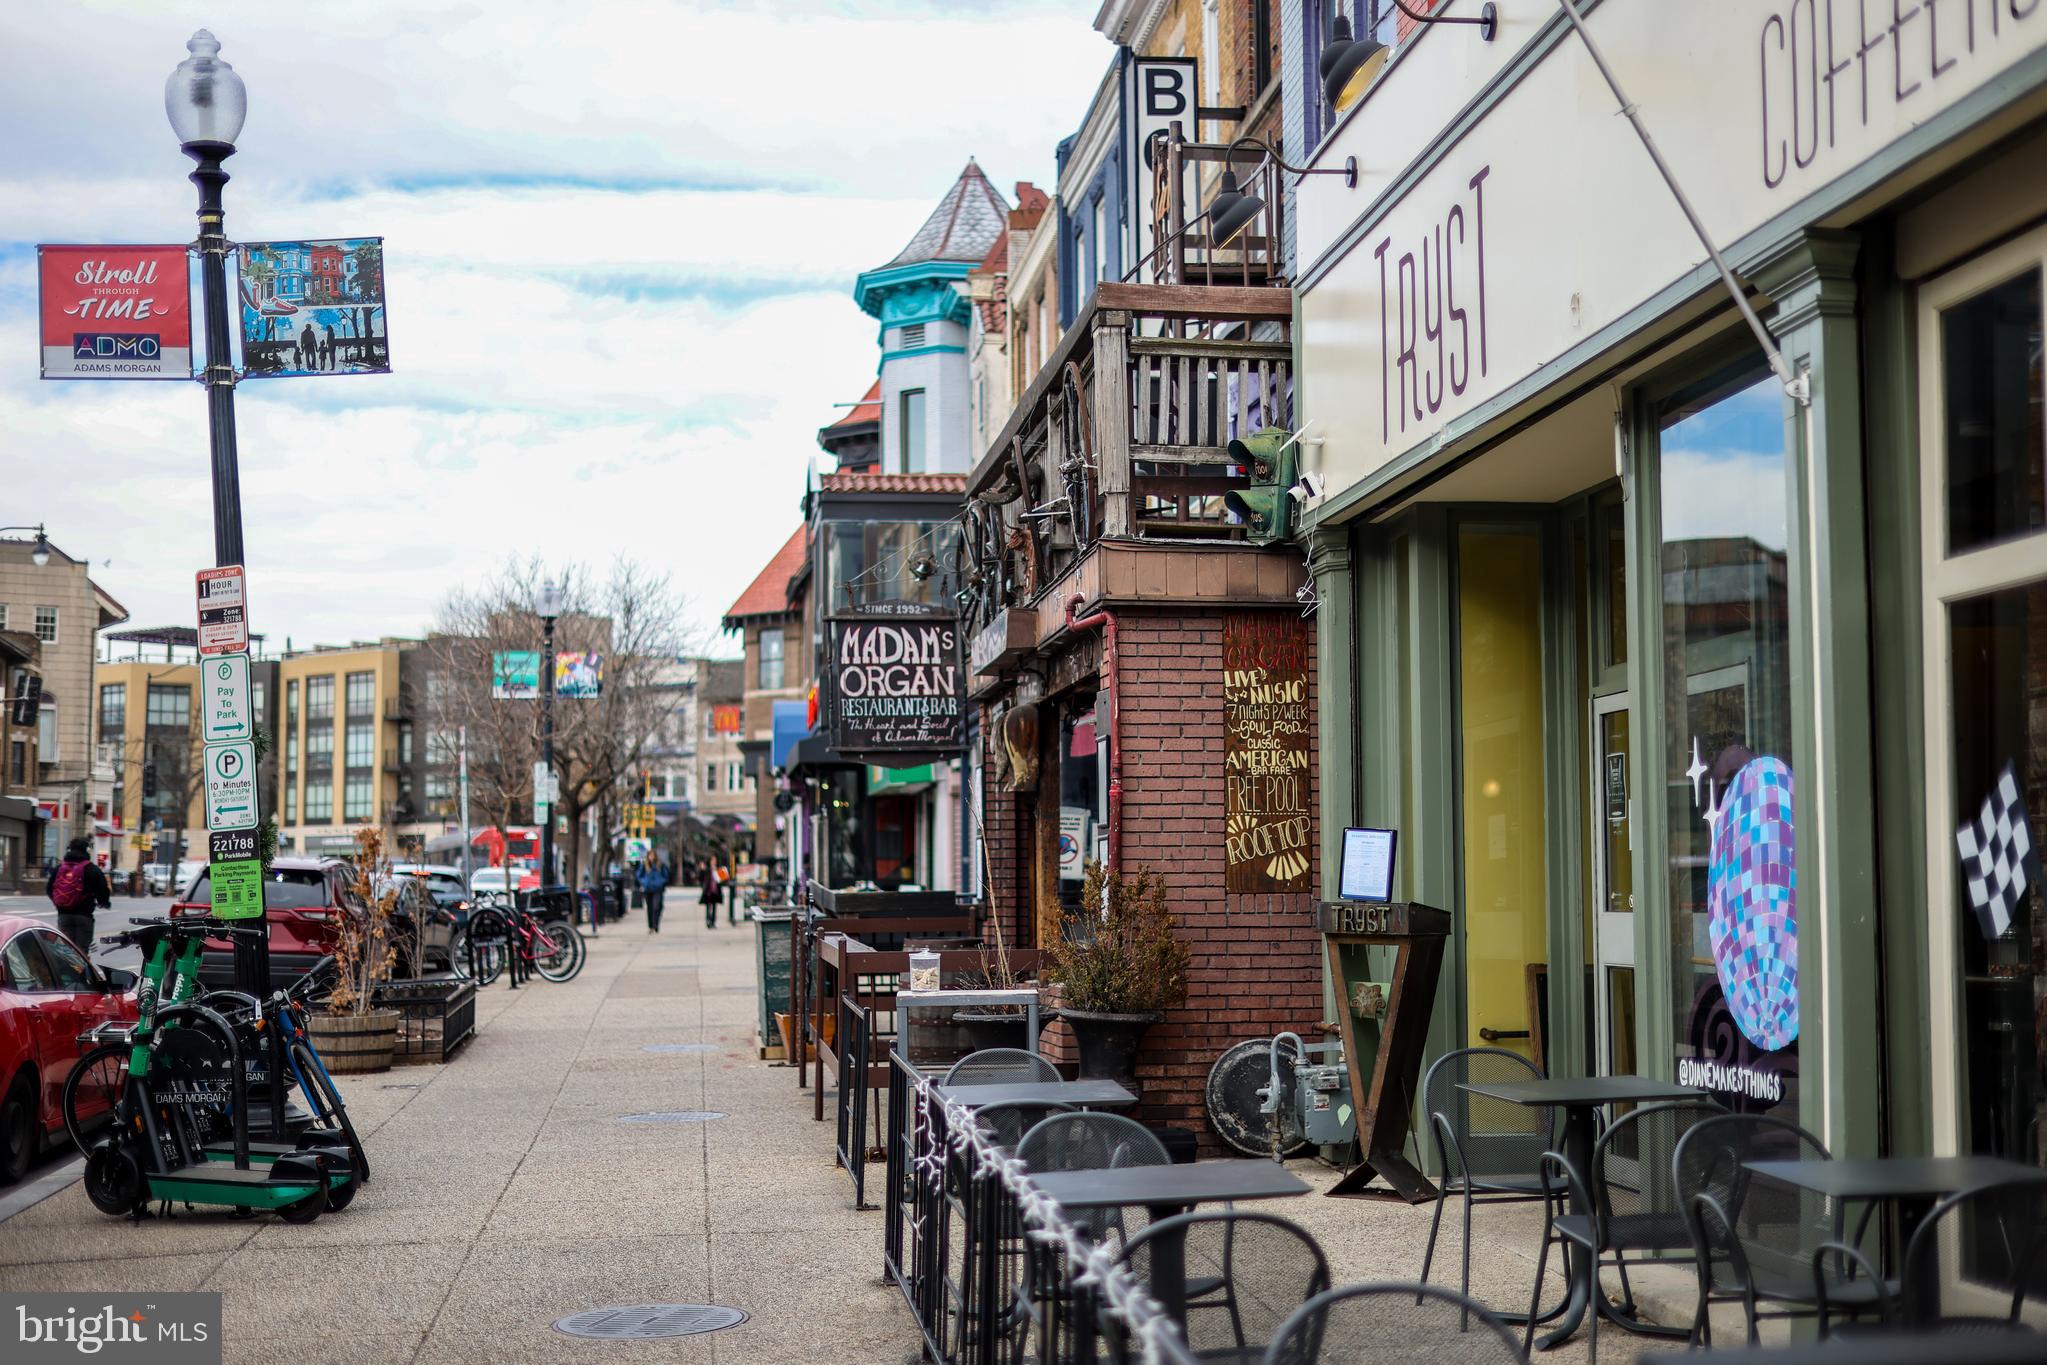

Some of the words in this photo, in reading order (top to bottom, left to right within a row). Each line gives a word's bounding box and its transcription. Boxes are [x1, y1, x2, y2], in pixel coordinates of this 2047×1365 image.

[75, 261, 157, 285] Stroll
[79, 298, 154, 320] TIME
[1374, 165, 1490, 445] TRYST
[76, 336, 158, 357] ADMO
[73, 364, 111, 373] ADAMS
[114, 364, 160, 373] MORGAN
[202, 582, 206, 597] 1
[211, 581, 232, 589] HOUR
[223, 608, 241, 616] Zone:
[864, 605, 893, 613] SINCE
[896, 605, 921, 614] 1992
[223, 615, 242, 623] 321788
[841, 626, 954, 664] MADAM'S
[840, 665, 955, 697] ORGAN
[1223, 669, 1261, 688] LIVE
[217, 687, 235, 697] Pay
[1250, 680, 1305, 704] MUSIC
[221, 700, 232, 708] To
[841, 698, 922, 716] RESTAURANT
[930, 698, 957, 715] BAR
[1226, 703, 1237, 719] 7
[216, 710, 237, 719] Park
[1240, 720, 1271, 739] SOUL
[1273, 720, 1301, 736] FOOD
[1247, 738, 1281, 749] CLASSIC
[1225, 750, 1307, 769] AMERICAN
[1270, 766, 1291, 775] FARE
[210, 782, 219, 791] 10
[223, 780, 251, 789] Minutes
[1228, 776, 1260, 812] FREE
[1266, 775, 1307, 812] POOL
[213, 838, 254, 851] 221788
[1331, 906, 1390, 932] TRYST
